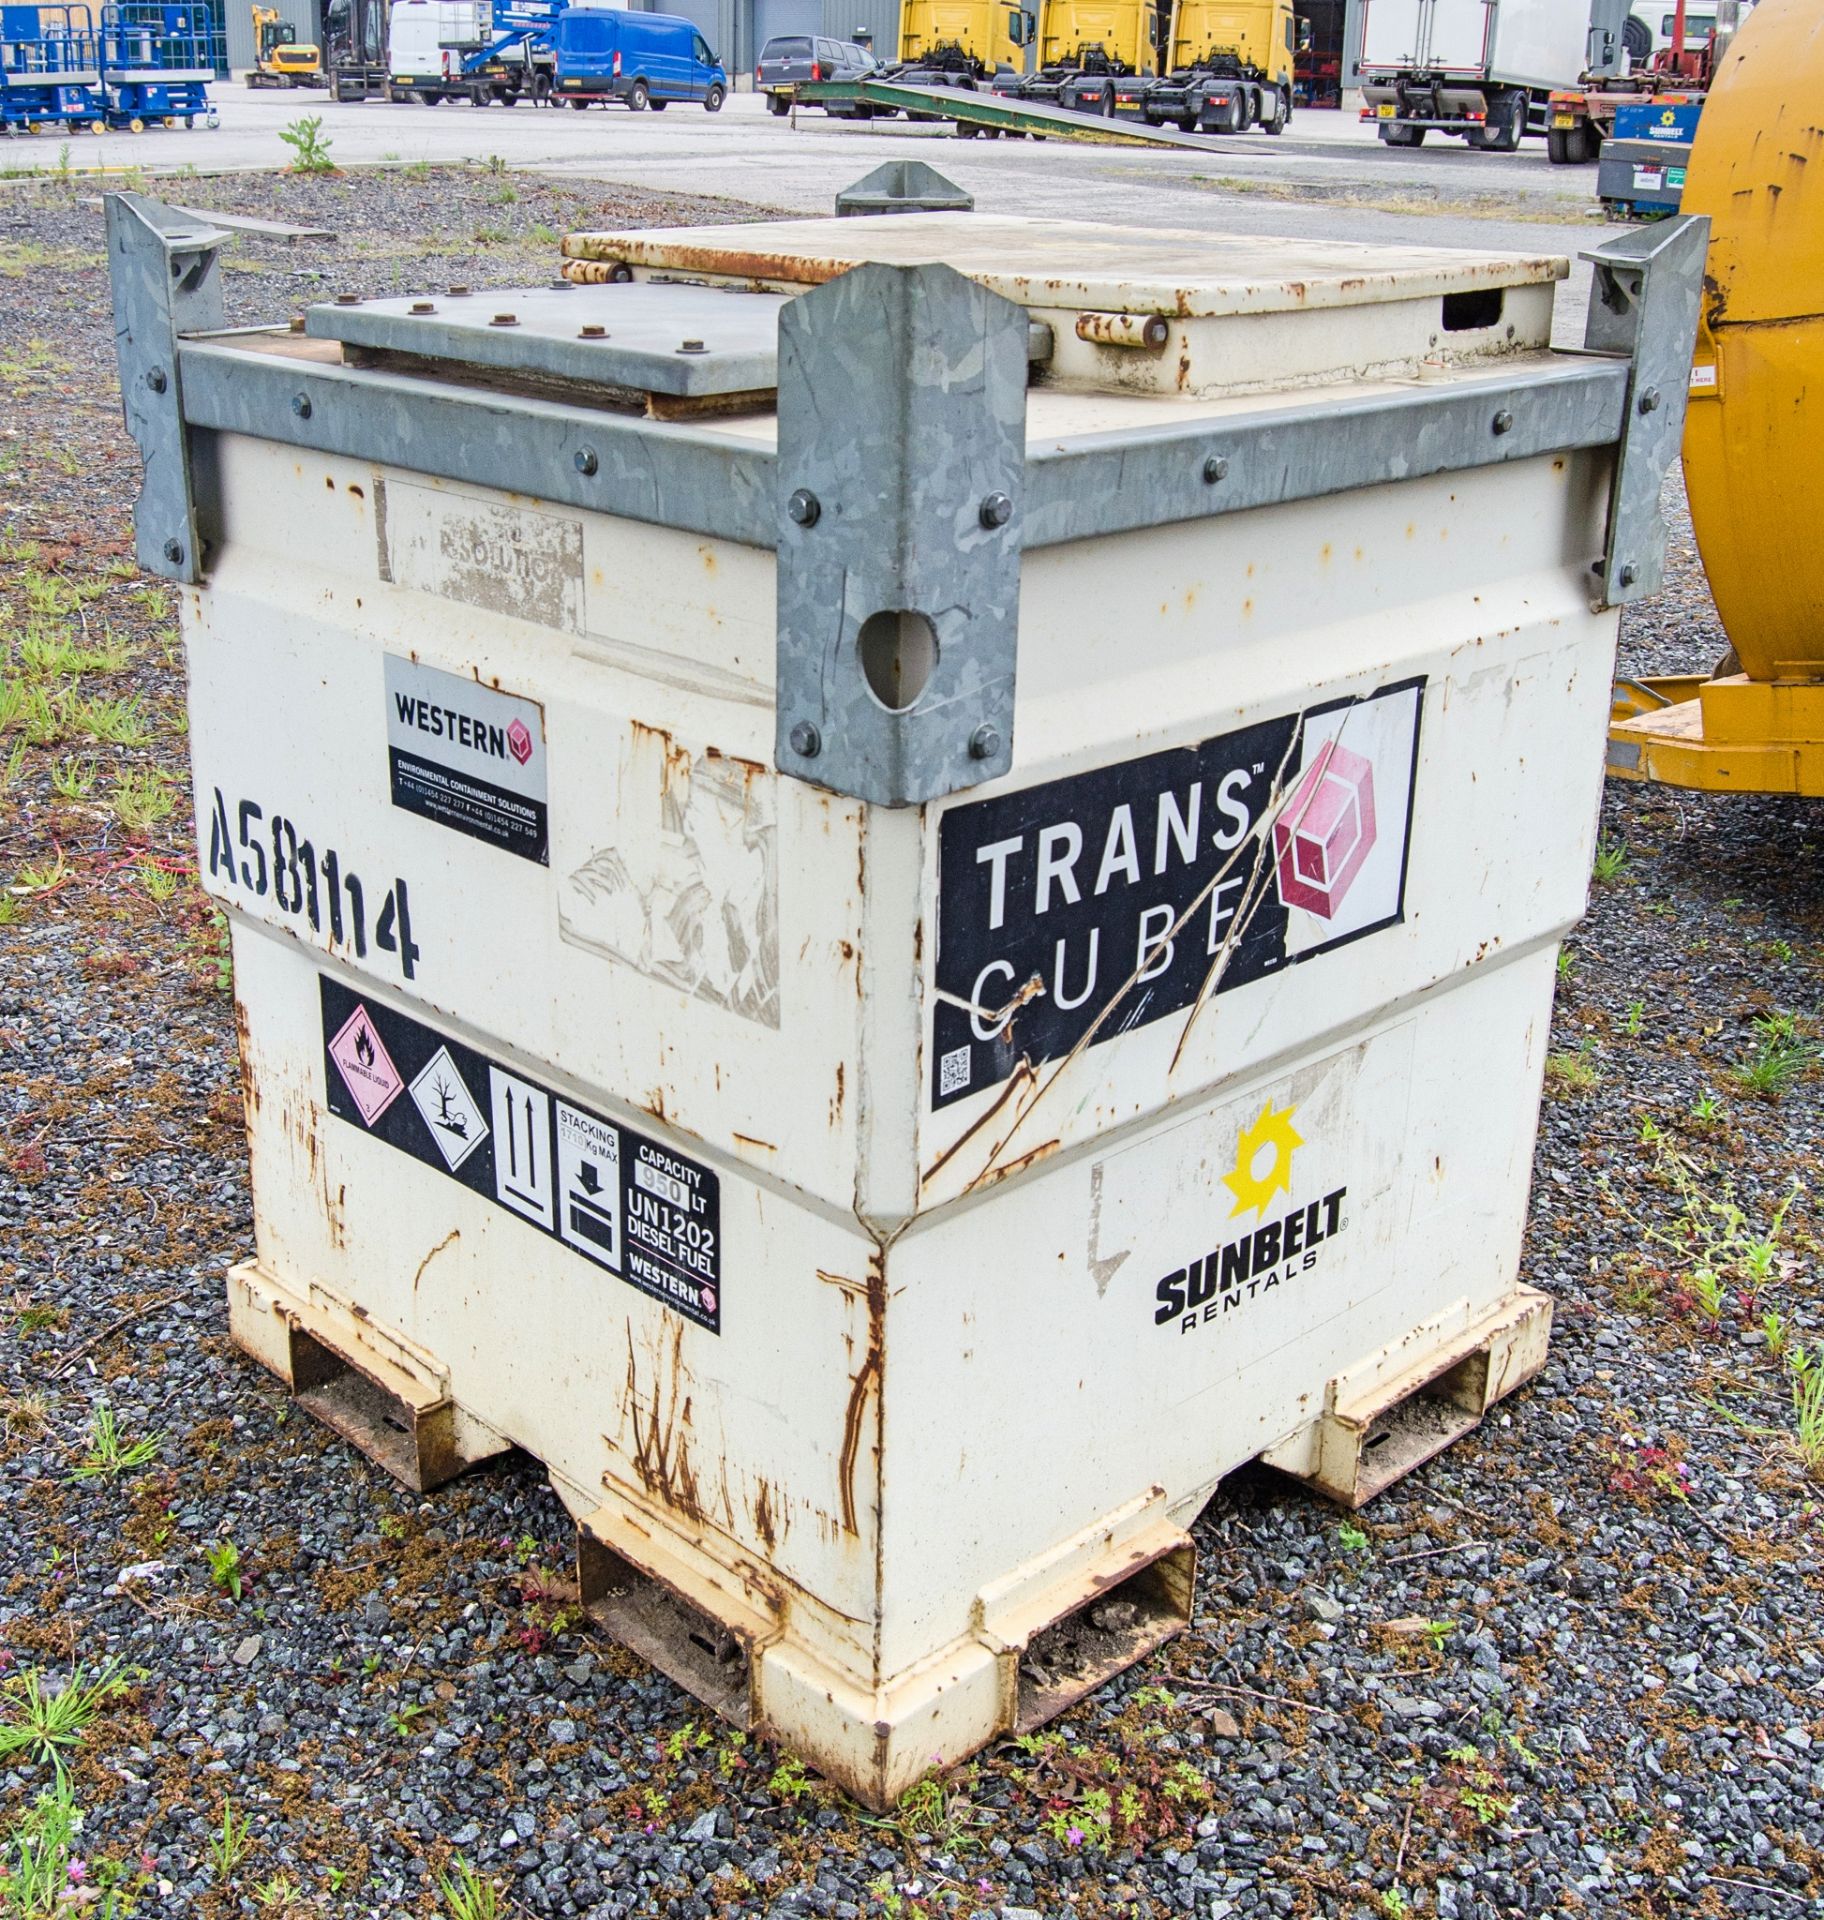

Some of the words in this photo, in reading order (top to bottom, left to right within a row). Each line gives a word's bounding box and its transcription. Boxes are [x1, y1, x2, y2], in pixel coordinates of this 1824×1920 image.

[395, 692, 505, 760] WESTERN
[398, 759, 449, 787] ENVIRONMENTAL
[450, 780, 497, 804] CONTAINMENT
[497, 798, 537, 820] SOLUTIONS
[510, 821, 523, 832] 227
[976, 769, 1252, 930] TRANS
[210, 786, 420, 980] A581114
[970, 876, 1244, 1041] CUBE
[342, 1058, 372, 1081] FLAMMABLE
[373, 1073, 390, 1089] LIQUID
[560, 1110, 615, 1147] STACKING
[598, 1145, 618, 1164] MAX
[639, 1145, 702, 1189] CAPACITY
[643, 1166, 682, 1203] 950
[692, 1193, 708, 1215] LT
[628, 1188, 715, 1257] UN1202
[628, 1215, 677, 1258] DIESEL
[678, 1243, 716, 1280] FUEL
[629, 1252, 700, 1307] WESTERN
[1154, 1186, 1348, 1326] SUNBELT
[1181, 1250, 1317, 1335] RENTALS
